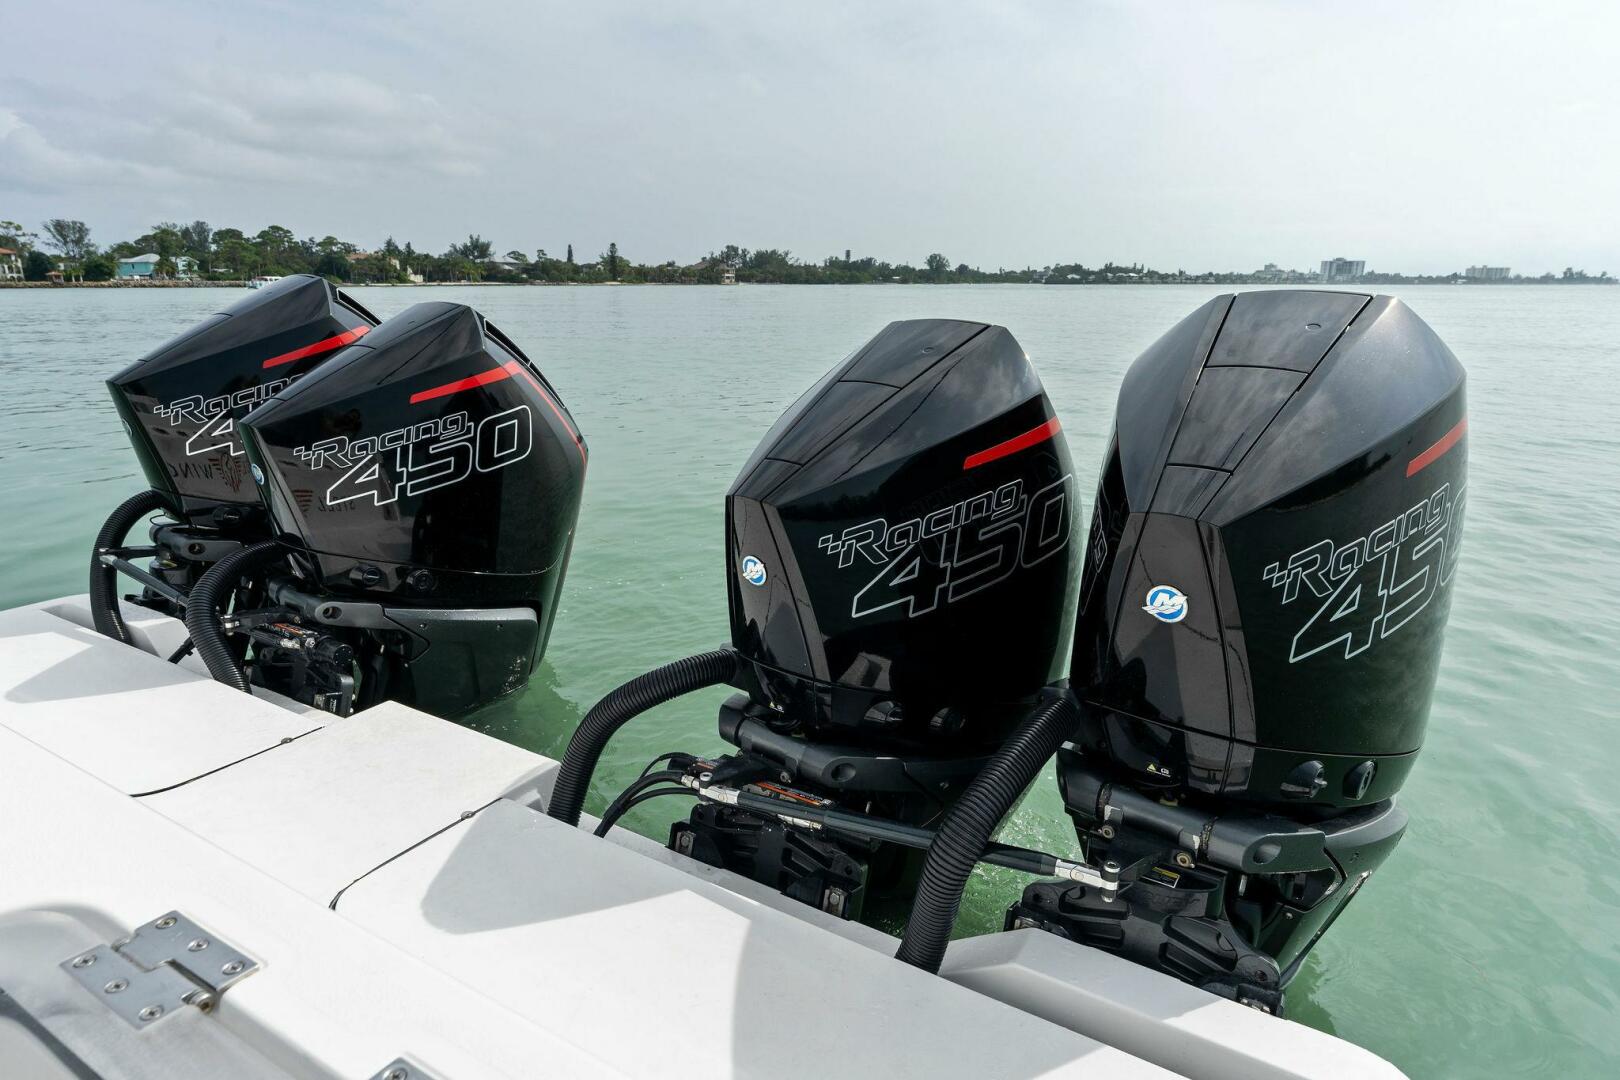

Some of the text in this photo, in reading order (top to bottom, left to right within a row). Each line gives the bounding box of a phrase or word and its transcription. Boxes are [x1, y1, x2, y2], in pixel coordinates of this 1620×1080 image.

[310, 409, 474, 471] Racing
[325, 404, 533, 507] 450
[836, 478, 1027, 569] Racing
[851, 473, 1075, 619] 450
[1279, 481, 1451, 605] Racing
